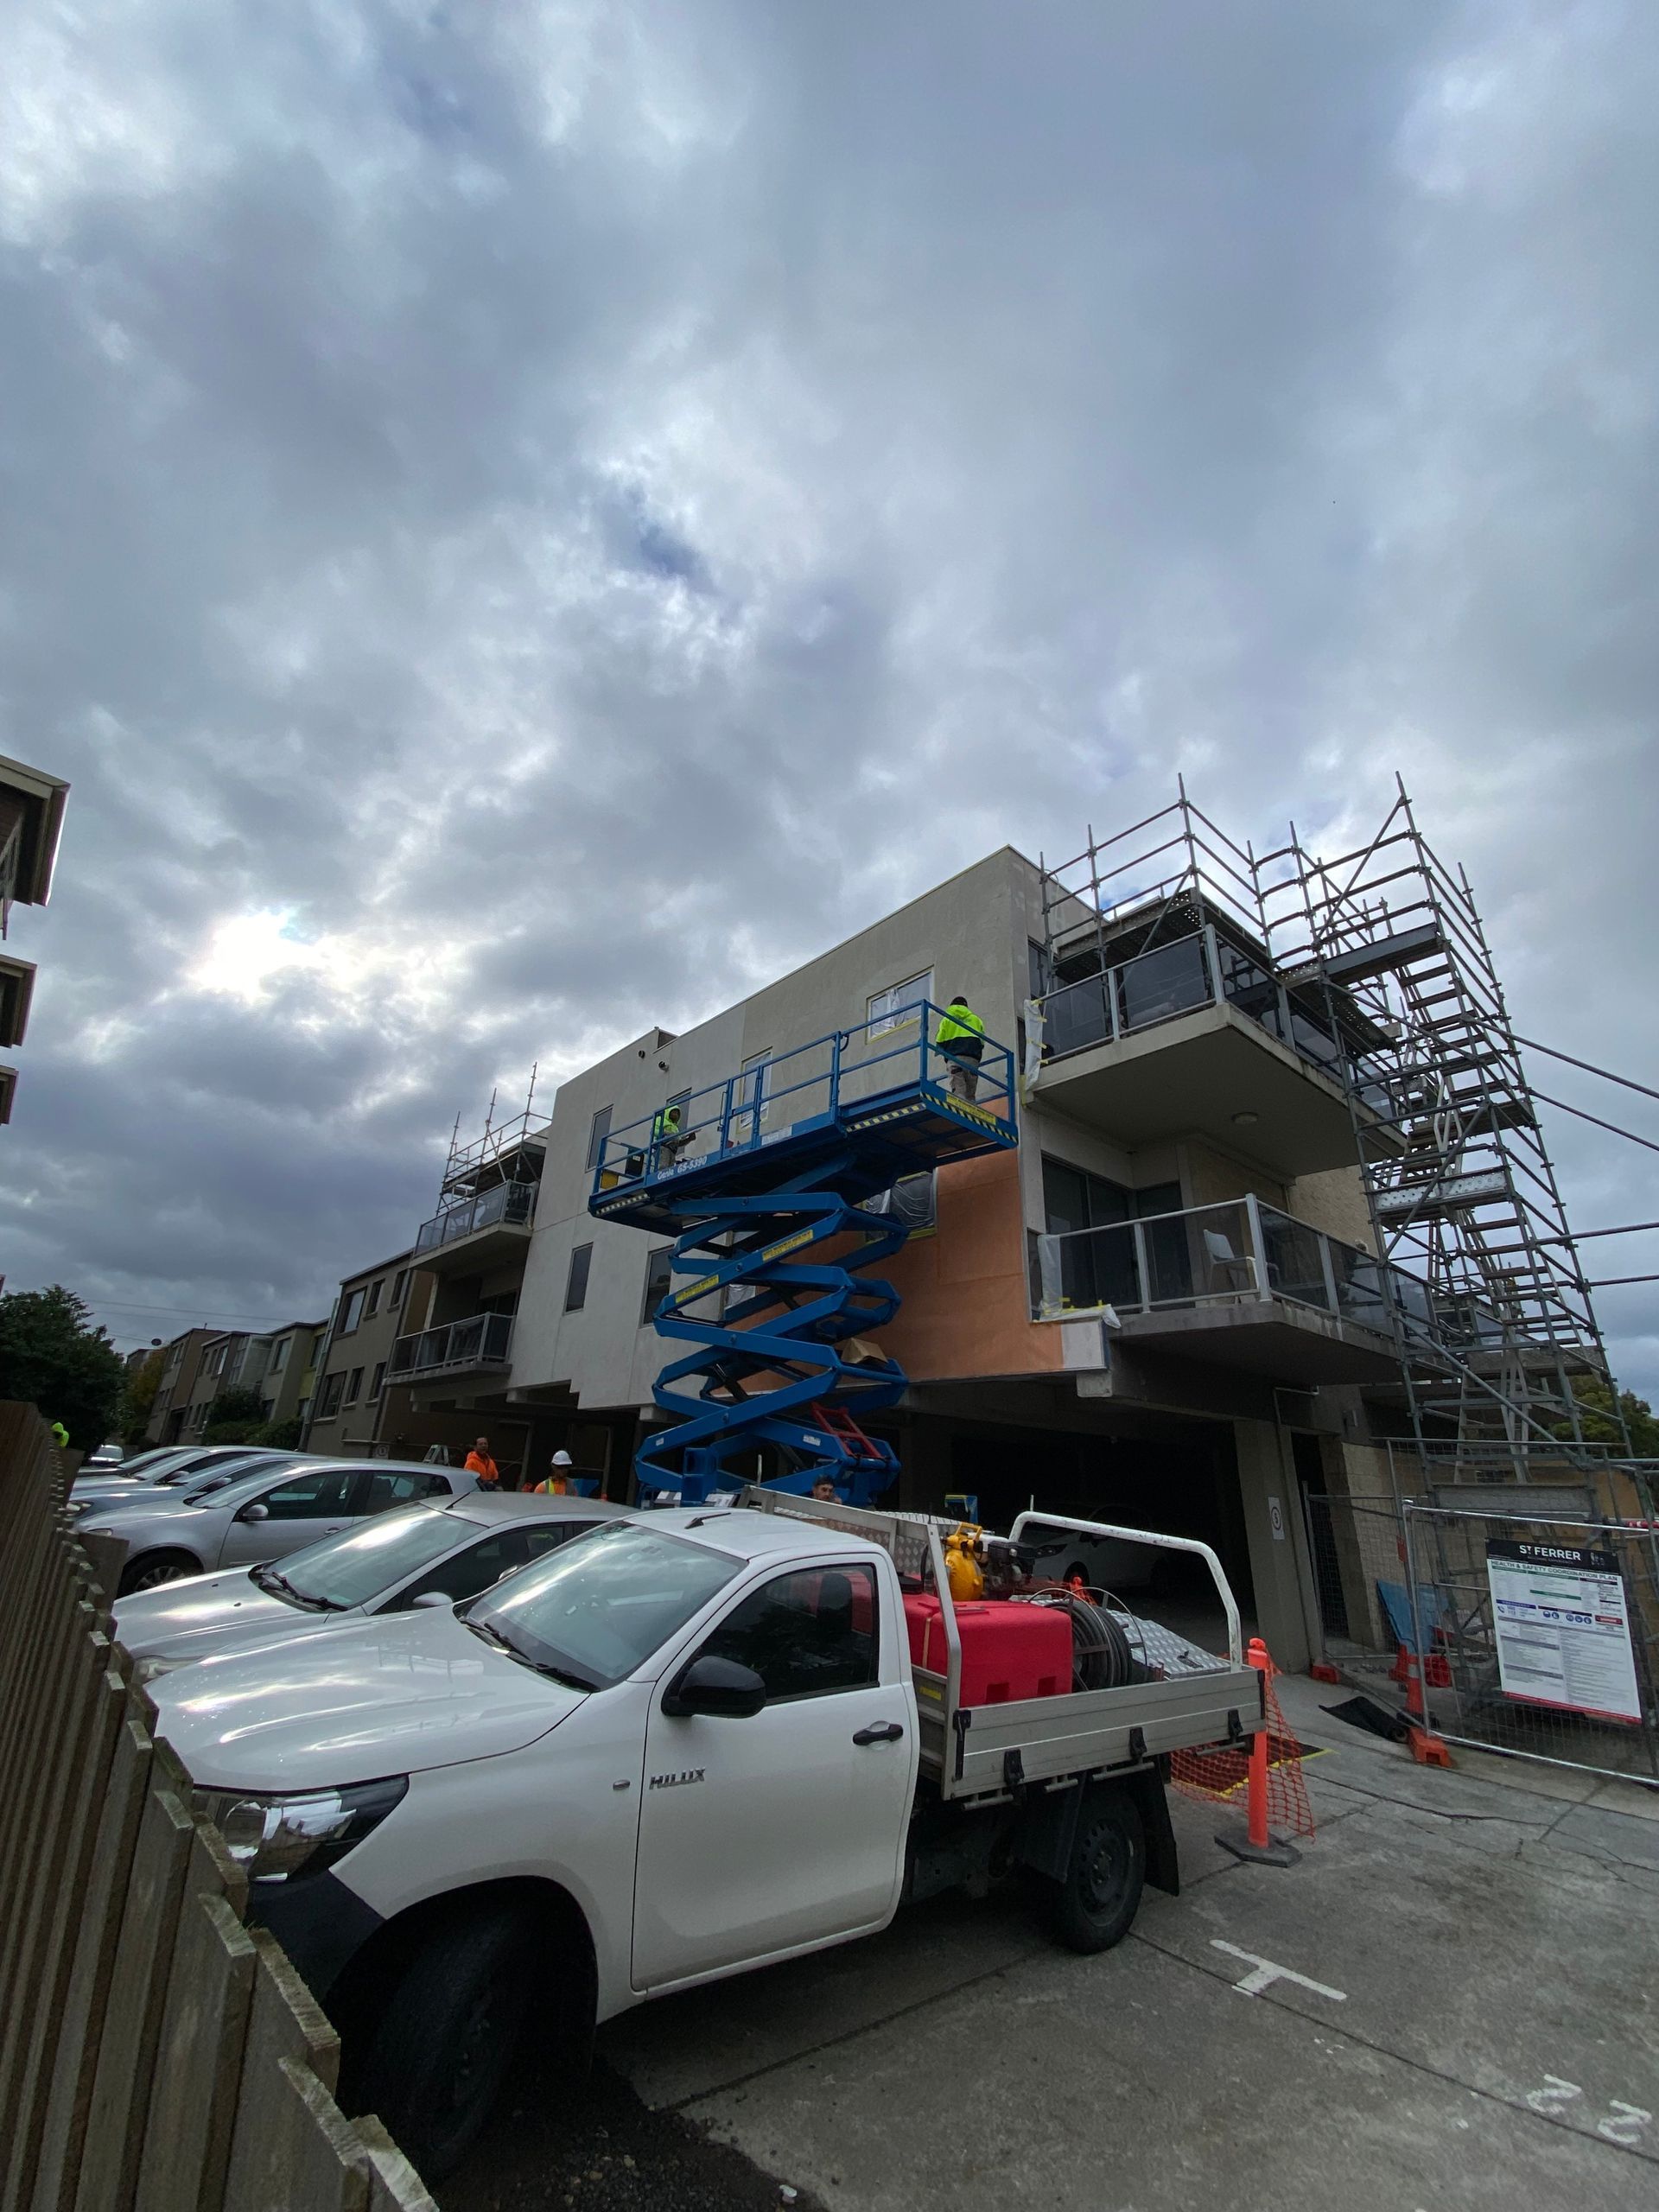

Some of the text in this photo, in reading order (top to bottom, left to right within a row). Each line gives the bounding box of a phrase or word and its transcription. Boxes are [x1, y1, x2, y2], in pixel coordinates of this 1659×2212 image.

[1534, 1548, 1582, 1560] FERRER
[1548, 1567, 1598, 1579] COORDINATION
[1599, 1573, 1618, 1581] PLAN
[649, 1767, 706, 1790] HILUX
